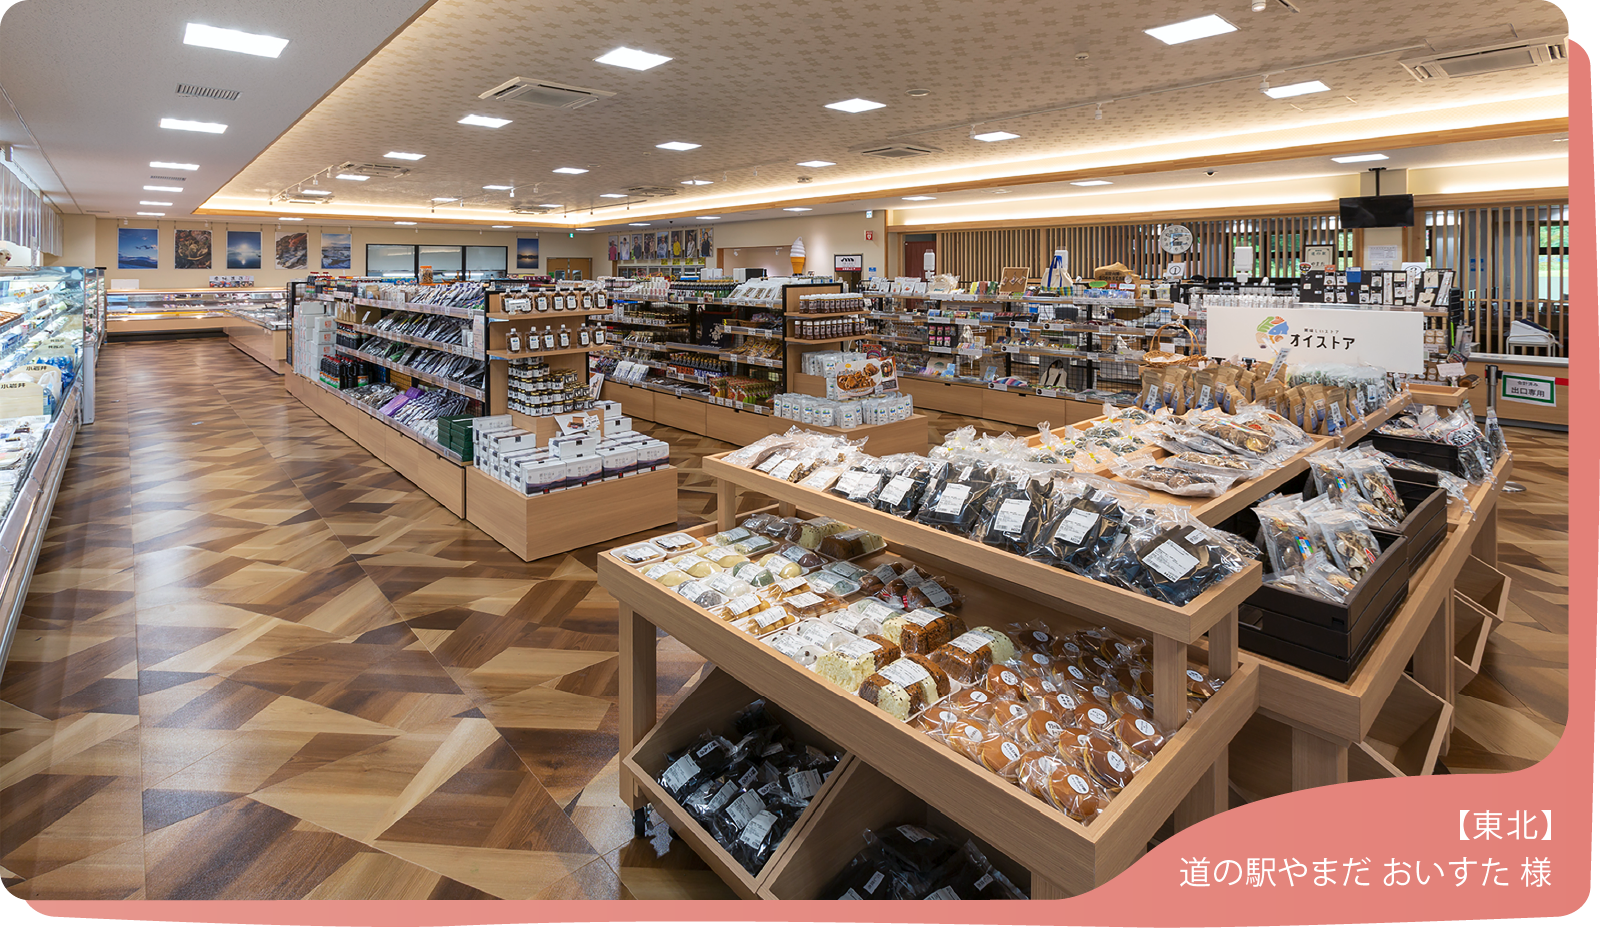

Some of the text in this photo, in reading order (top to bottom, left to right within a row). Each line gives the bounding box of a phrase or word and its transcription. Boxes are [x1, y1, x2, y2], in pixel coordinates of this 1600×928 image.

[1290, 334, 1355, 350] オイストア
[1511, 387, 1545, 397] 出口専用
